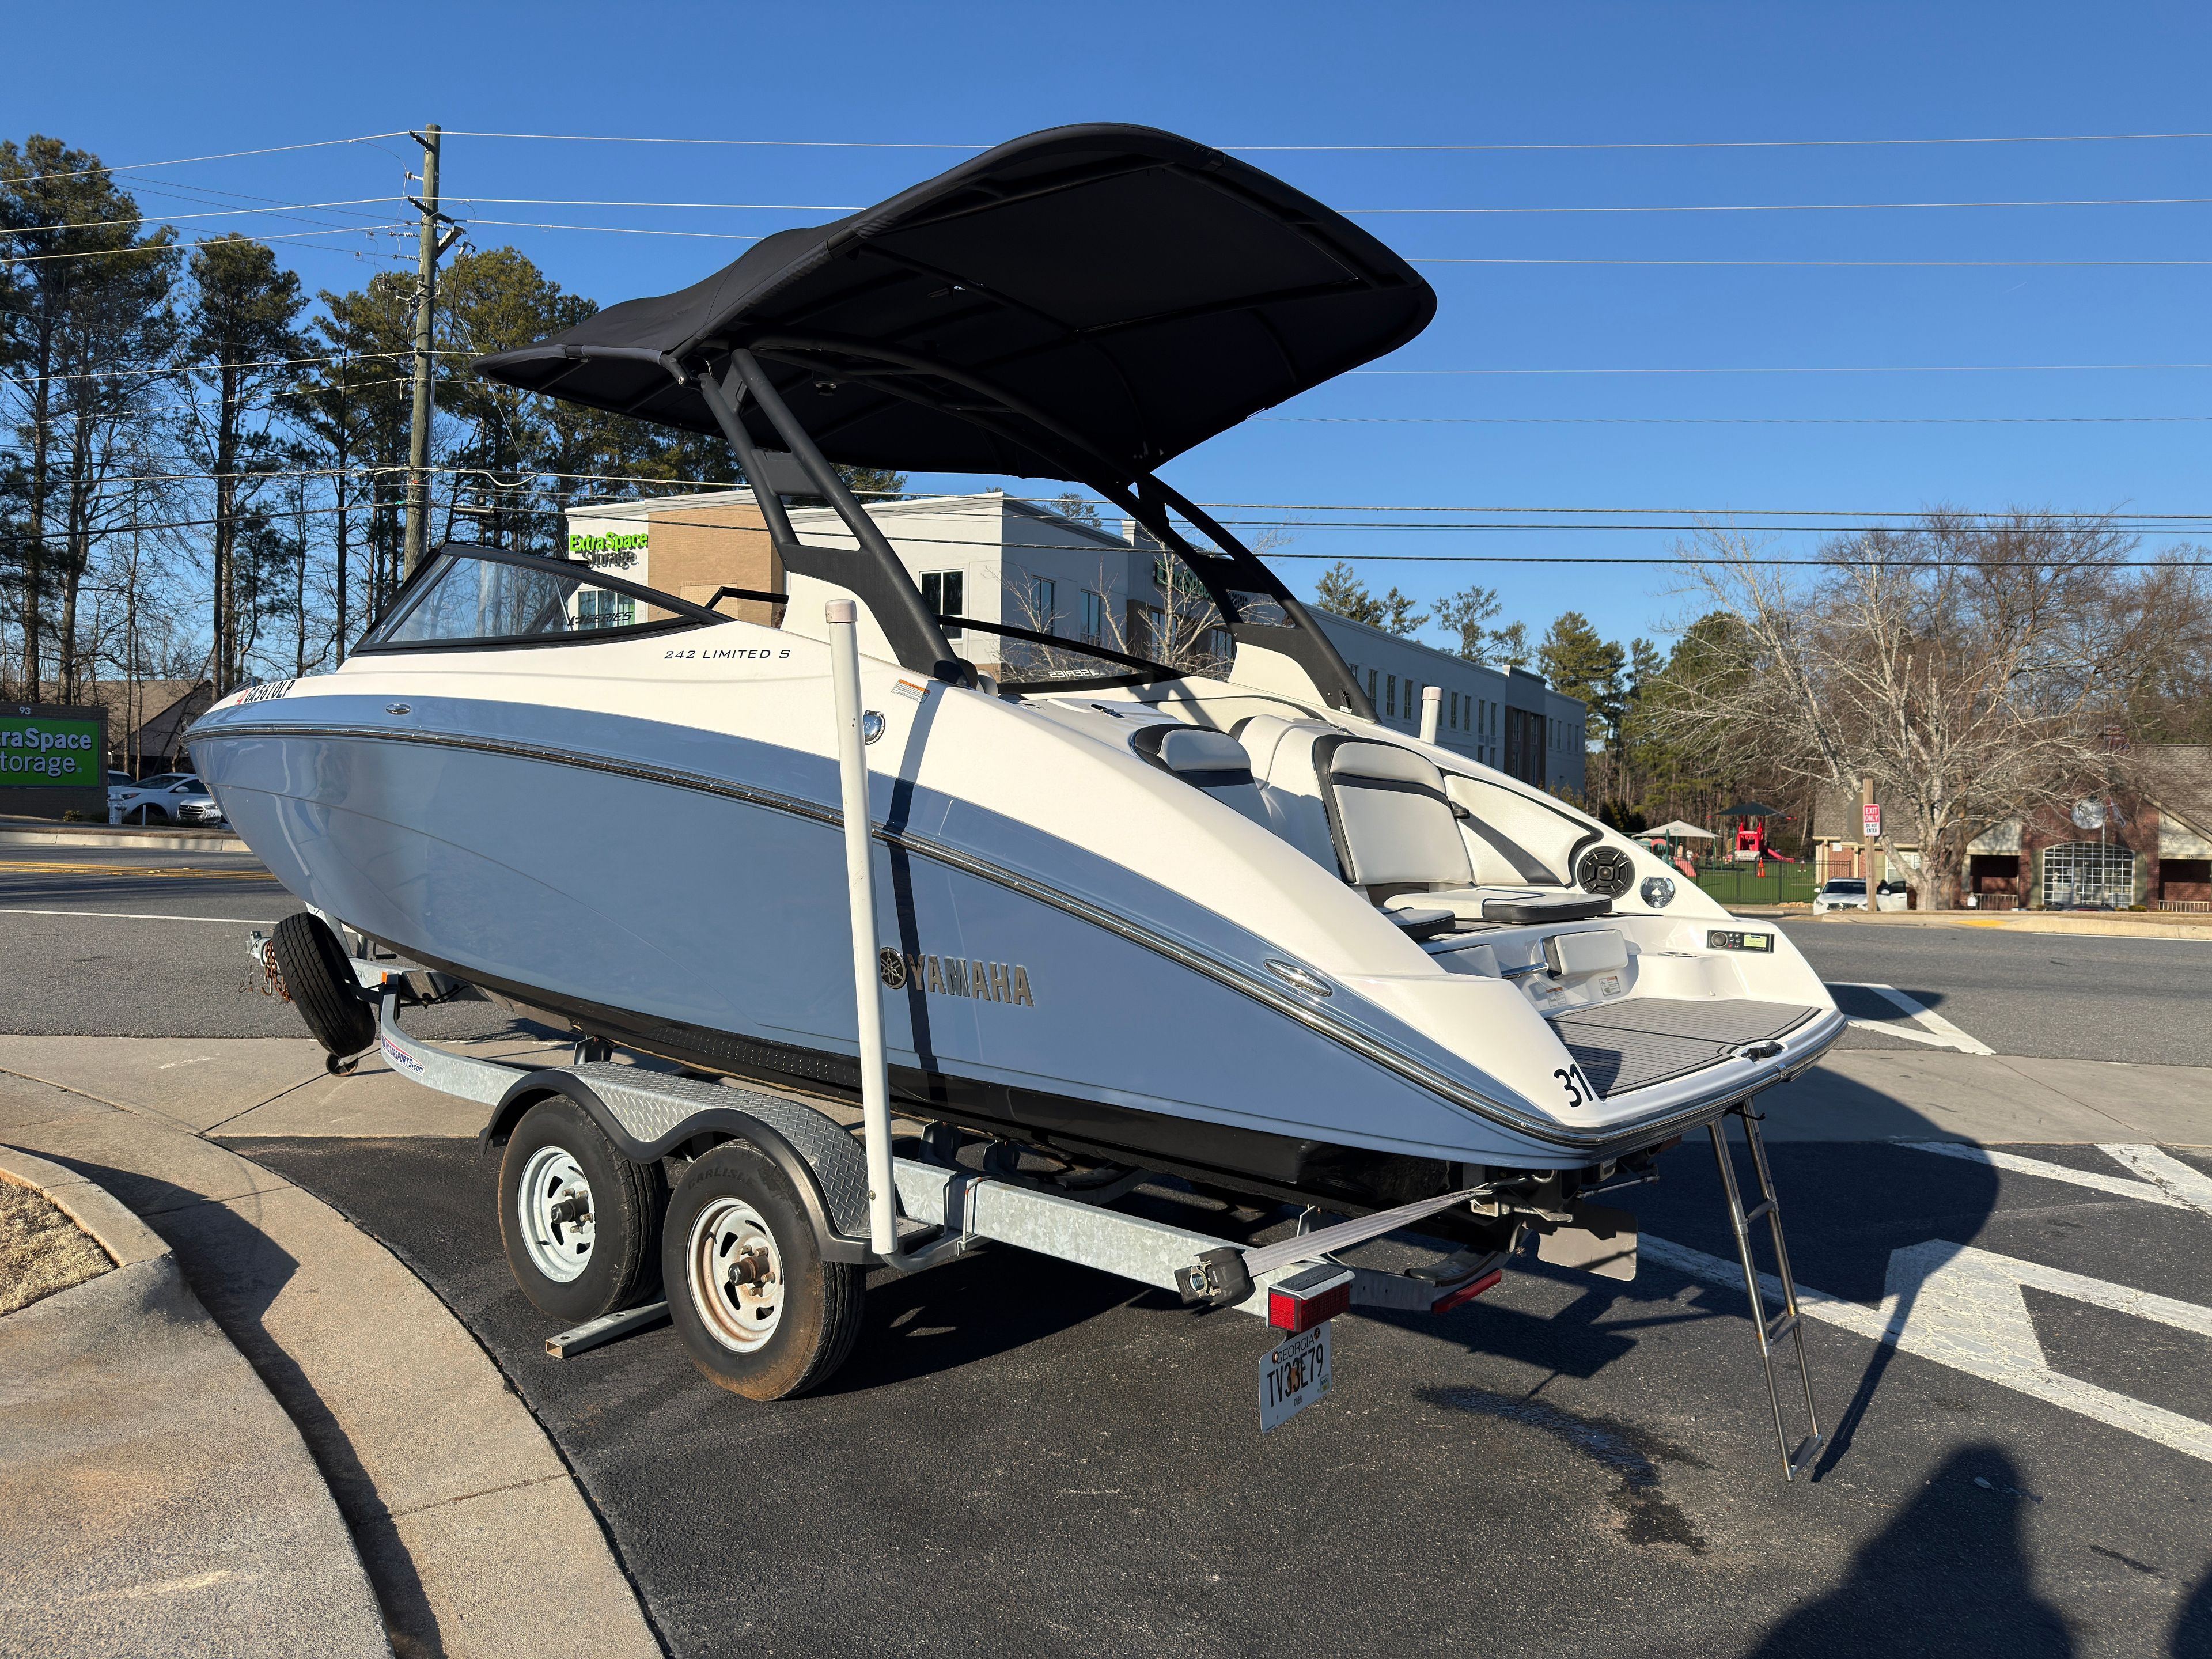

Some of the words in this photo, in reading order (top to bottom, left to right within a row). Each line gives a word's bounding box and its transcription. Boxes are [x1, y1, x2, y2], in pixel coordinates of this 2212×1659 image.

[570, 535, 604, 551] Extra
[605, 531, 648, 552] Space
[664, 650, 696, 659] 242
[702, 649, 771, 658] LIMITED
[779, 649, 791, 658] S
[19, 706, 31, 715] 93
[0, 751, 76, 777] torage
[907, 953, 1035, 1007] YAMAHA
[1554, 1063, 1594, 1108] 31
[1277, 1334, 1315, 1365] GEORGIA
